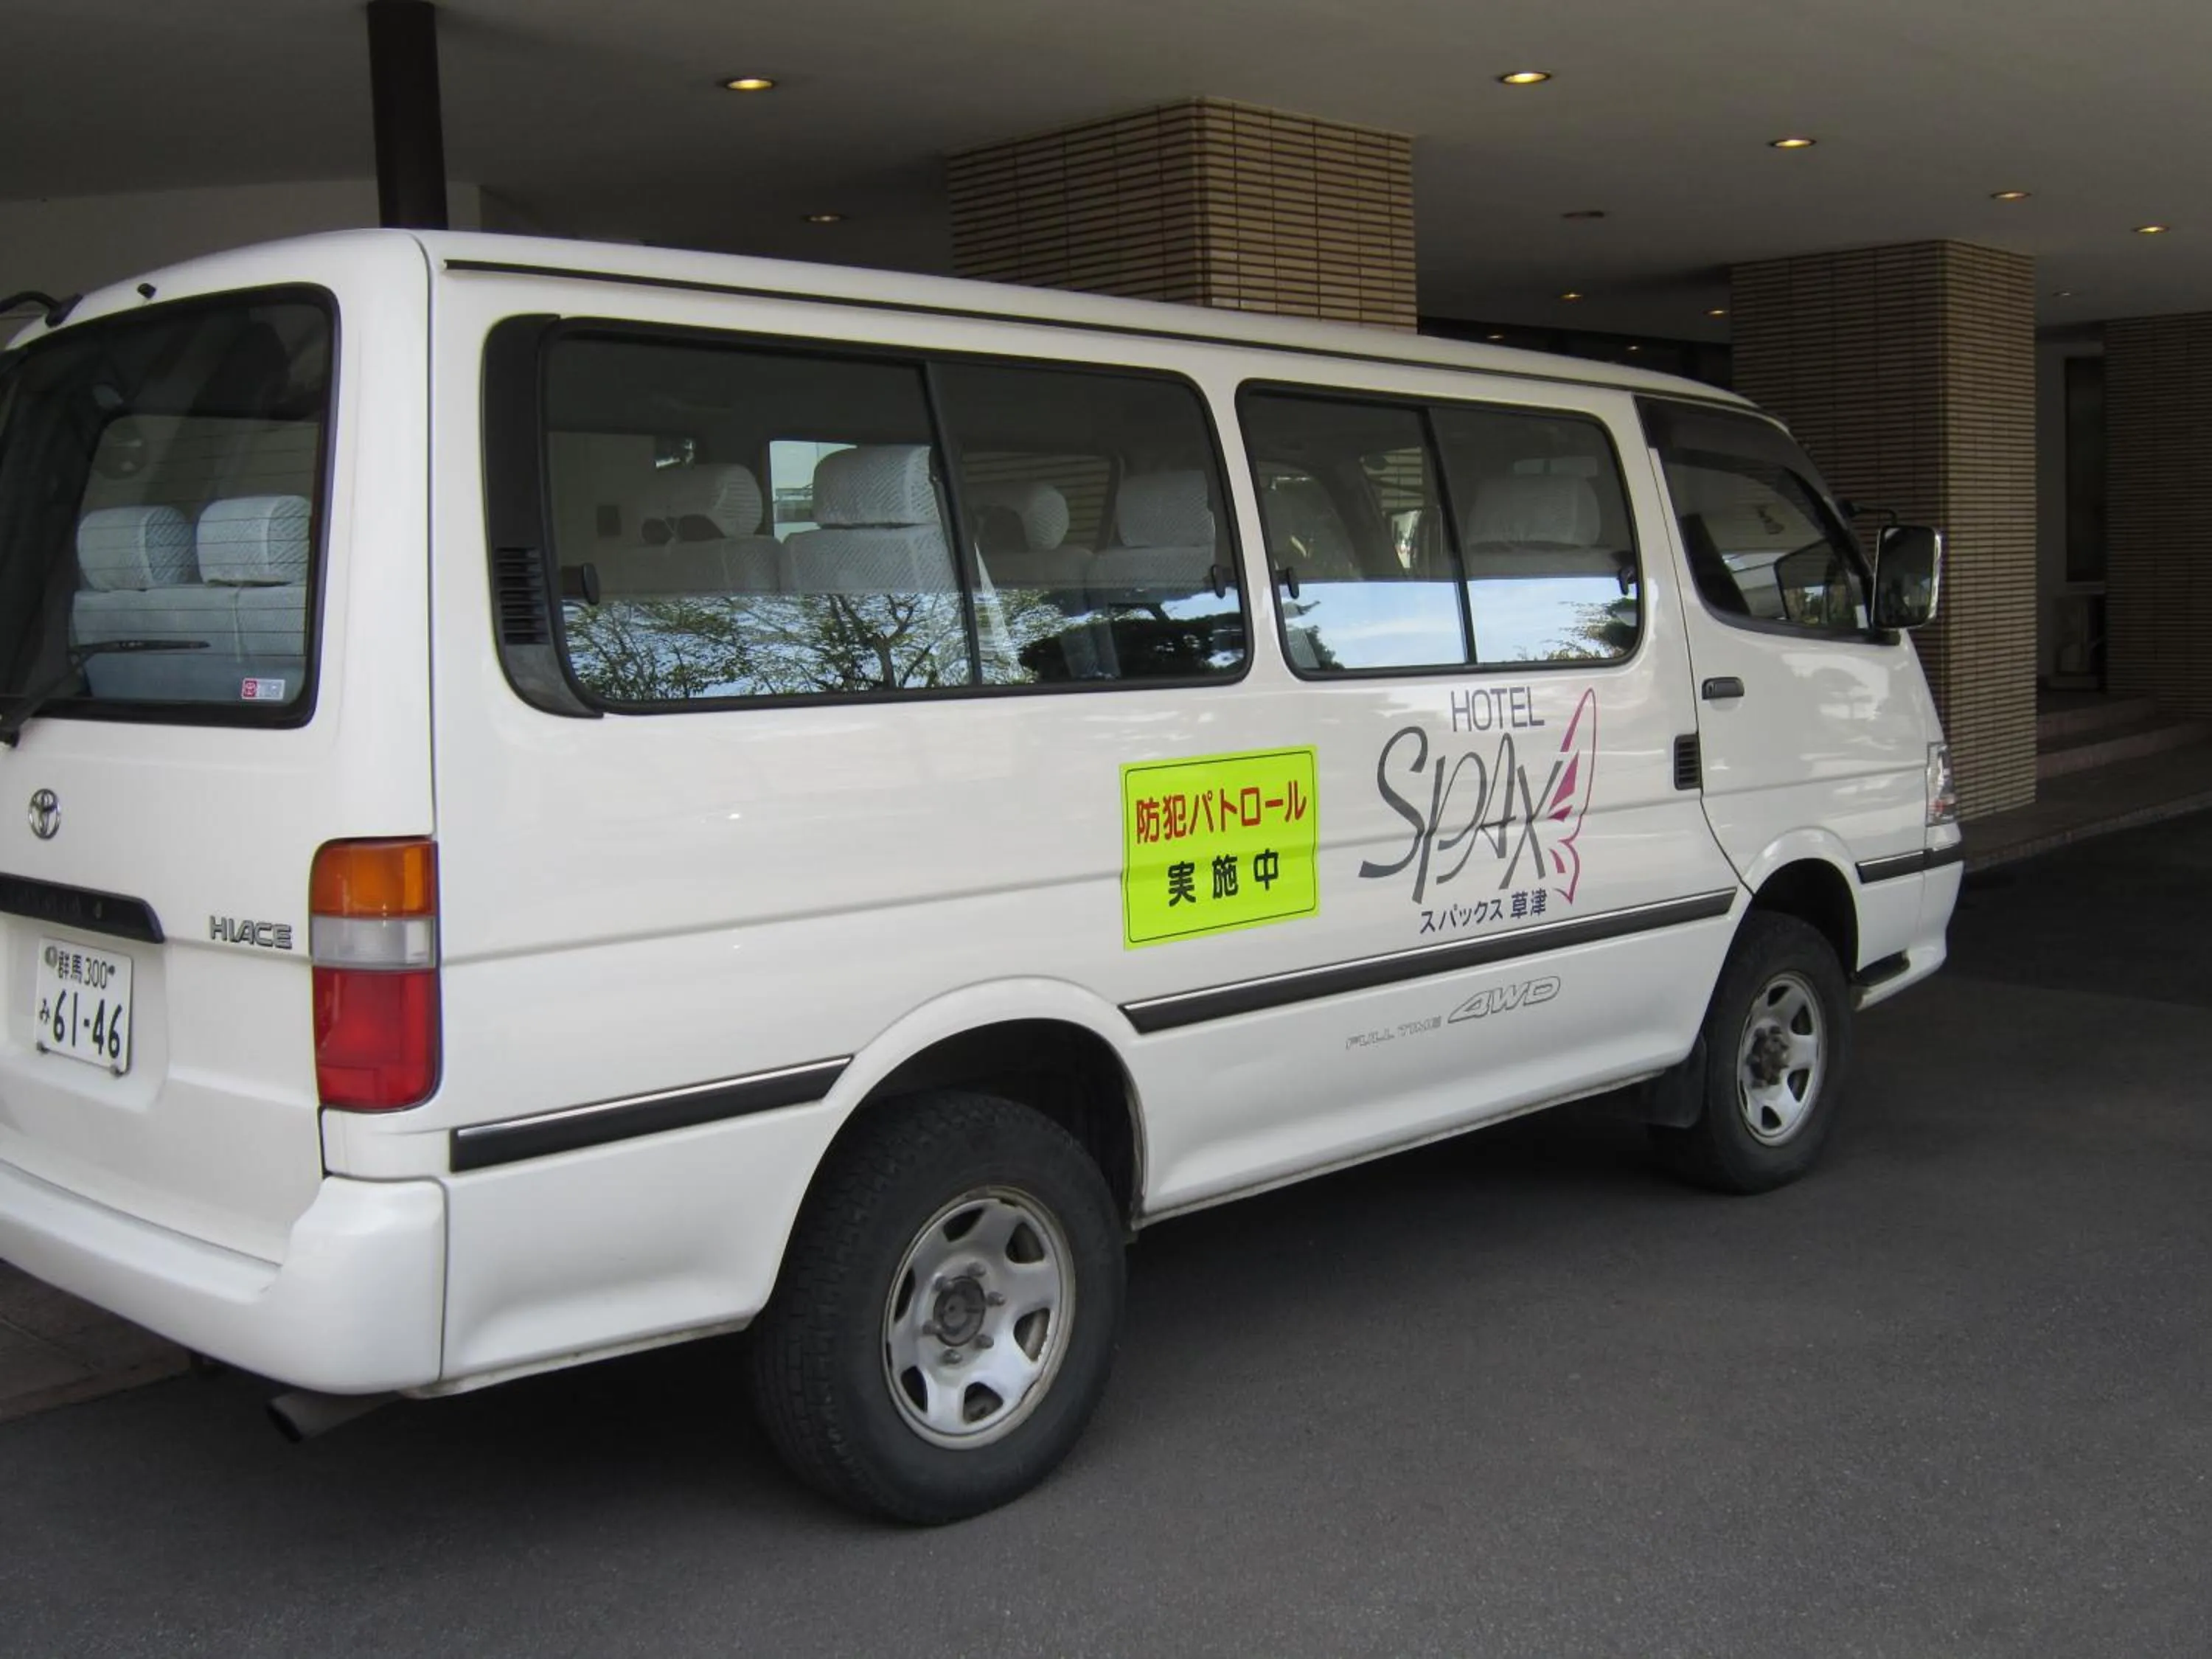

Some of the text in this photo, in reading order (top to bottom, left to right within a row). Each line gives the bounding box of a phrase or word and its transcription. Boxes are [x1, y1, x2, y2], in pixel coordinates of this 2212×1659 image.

[1450, 686, 1545, 732] HOTEL
[1136, 780, 1307, 844] 防犯パトロール
[1358, 726, 1563, 904] SPAX
[1167, 848, 1279, 908] 実施中
[209, 915, 293, 950] HIACE
[1419, 888, 1548, 934] スパックス 草津
[1346, 1029, 1395, 1050] FULL
[1447, 975, 1561, 1023] 4WD
